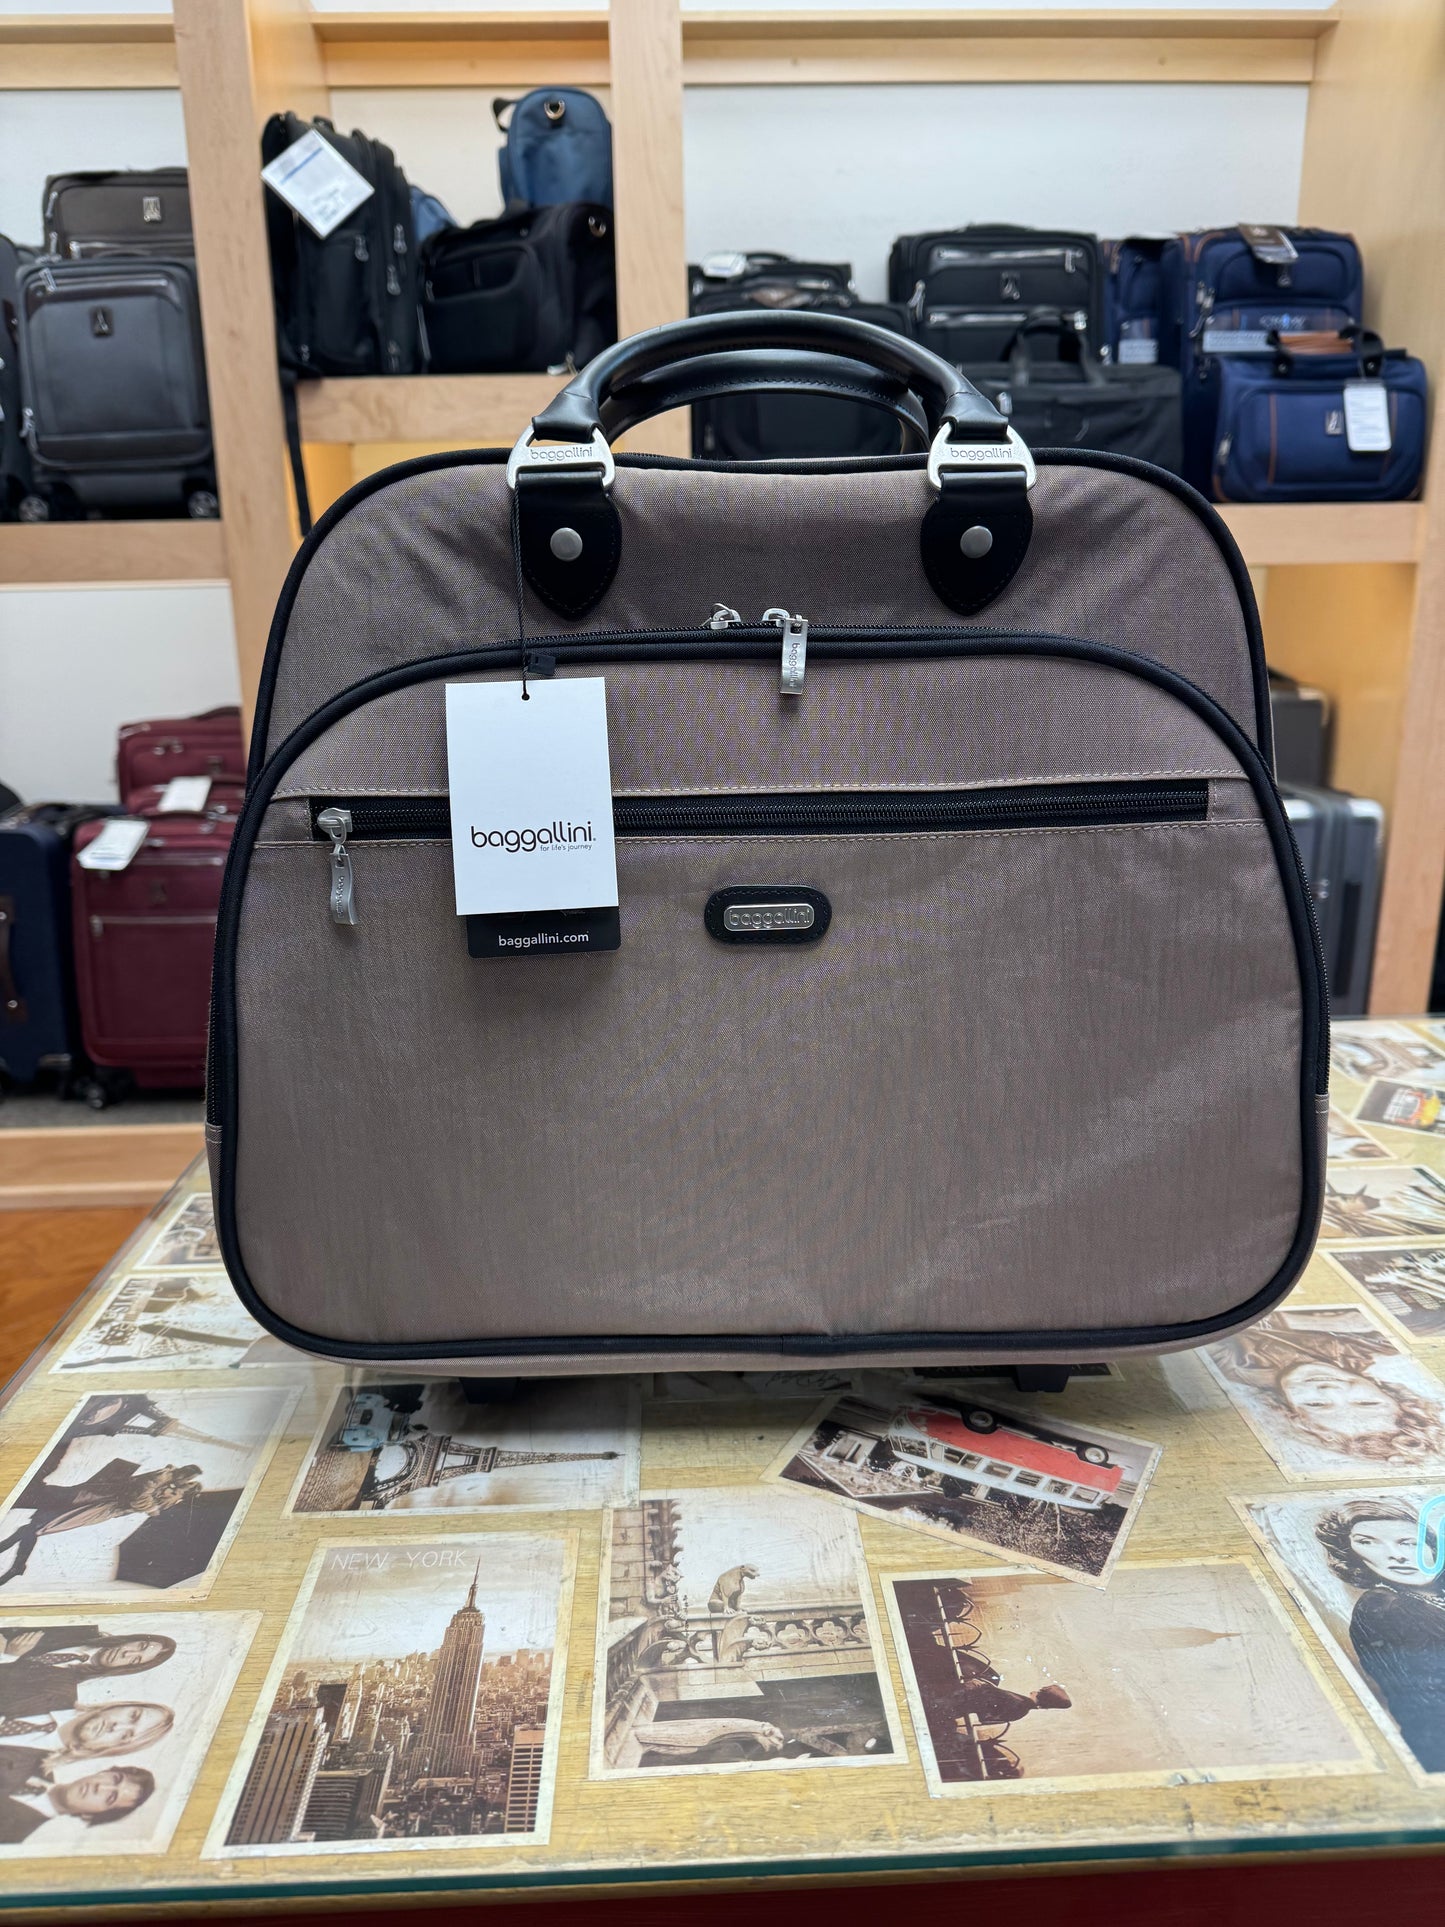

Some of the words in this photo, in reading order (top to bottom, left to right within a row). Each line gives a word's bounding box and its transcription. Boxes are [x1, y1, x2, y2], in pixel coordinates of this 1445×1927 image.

[530, 446, 593, 461] baggallini
[950, 447, 1013, 460] baggallini
[540, 844, 550, 852] for
[567, 843, 592, 852] journey
[729, 907, 811, 929] baggallini
[498, 932, 590, 948] baggallini.com
[331, 1552, 390, 1570] NEW
[406, 1550, 467, 1568] YORK
